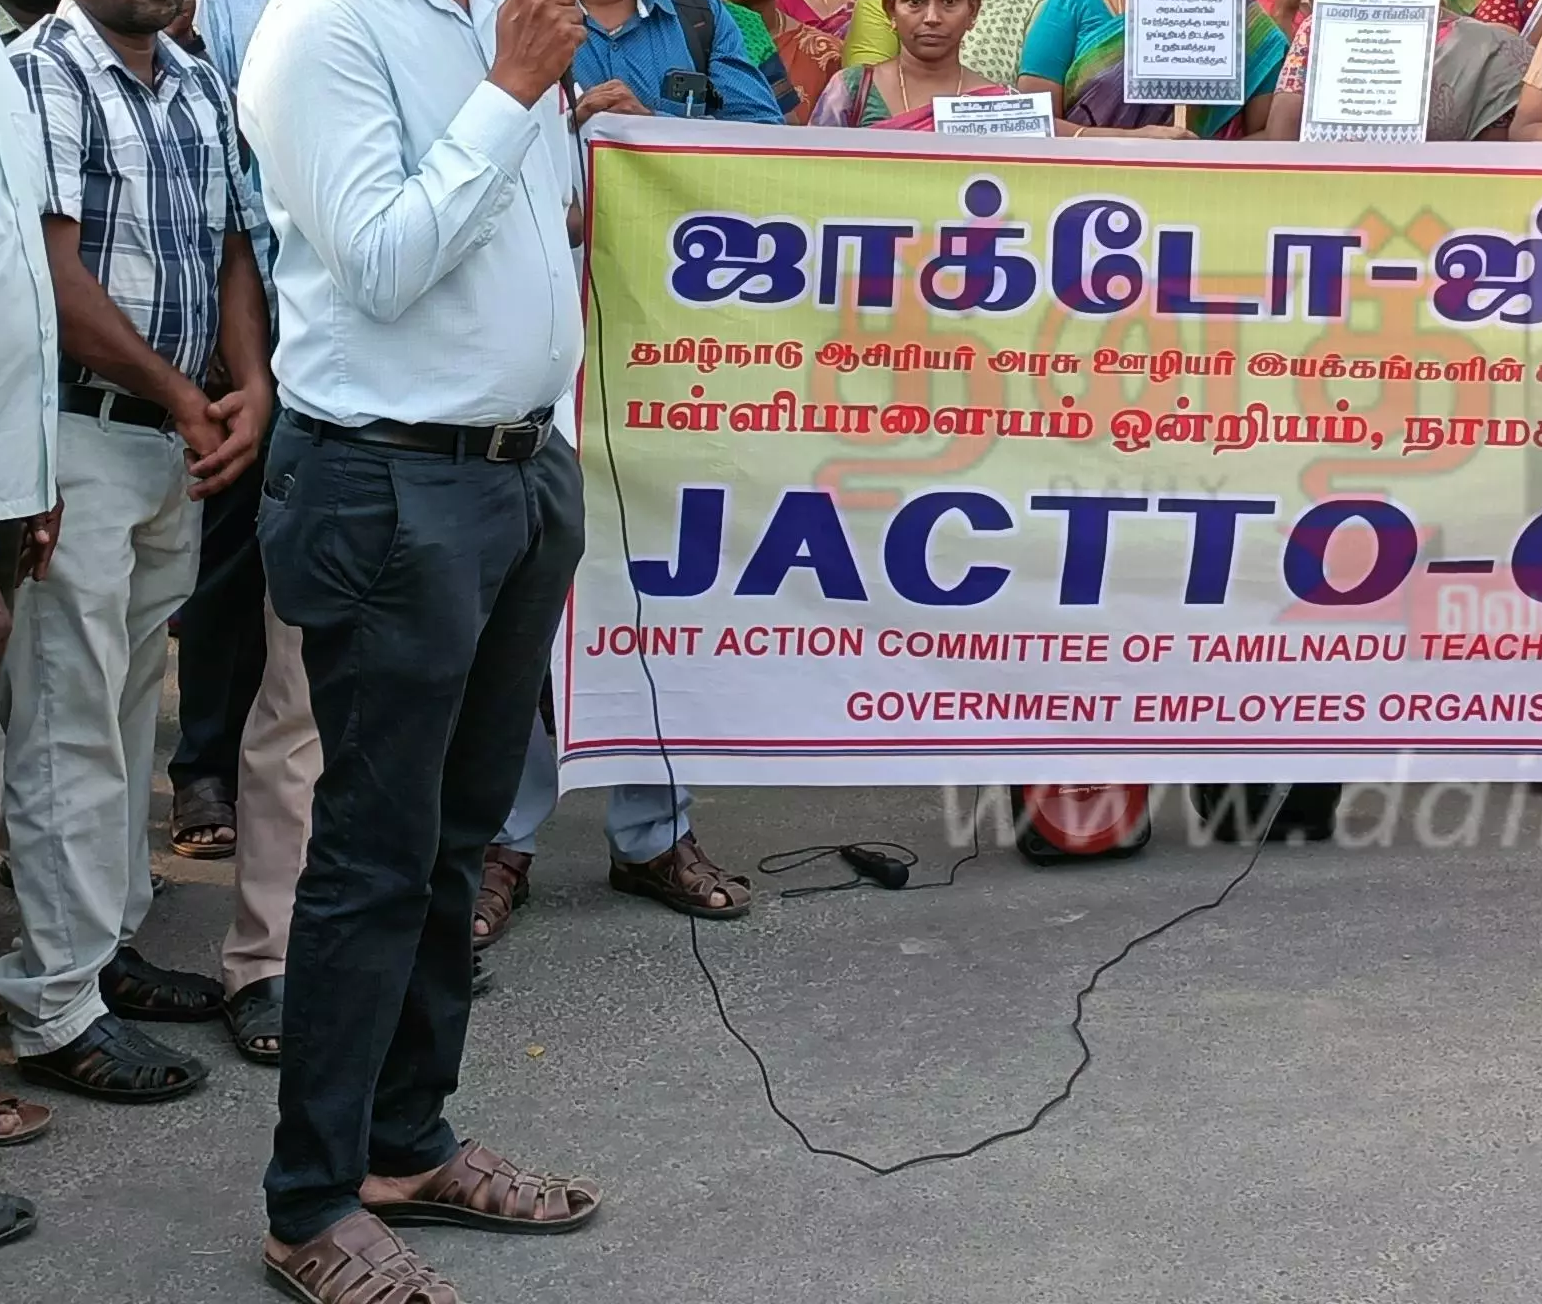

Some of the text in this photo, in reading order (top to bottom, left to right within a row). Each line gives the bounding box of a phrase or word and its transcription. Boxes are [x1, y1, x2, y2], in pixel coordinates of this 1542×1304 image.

[1327, 8, 1425, 21] மனித சங்கிலி
[947, 118, 1040, 134] மனித சங்கிலி
[627, 336, 803, 371] தமிழ்நாடு
[816, 341, 975, 374] ஆசிரியர்
[987, 347, 1080, 377] அரசு
[1093, 348, 1235, 383] ஊழியர்
[625, 384, 1093, 442] பள்ளிபாளையம்
[1109, 397, 1383, 454] ஒன்றியம்,
[586, 625, 703, 657] JOINT
[714, 626, 863, 657] ACTION
[877, 629, 1108, 663] COMMITTEE
[1122, 634, 1175, 663] OF
[1186, 633, 1407, 664] TAMILNADU
[847, 691, 1121, 724] GOVERNMENT
[1133, 693, 1365, 724] EMPLOYEES
